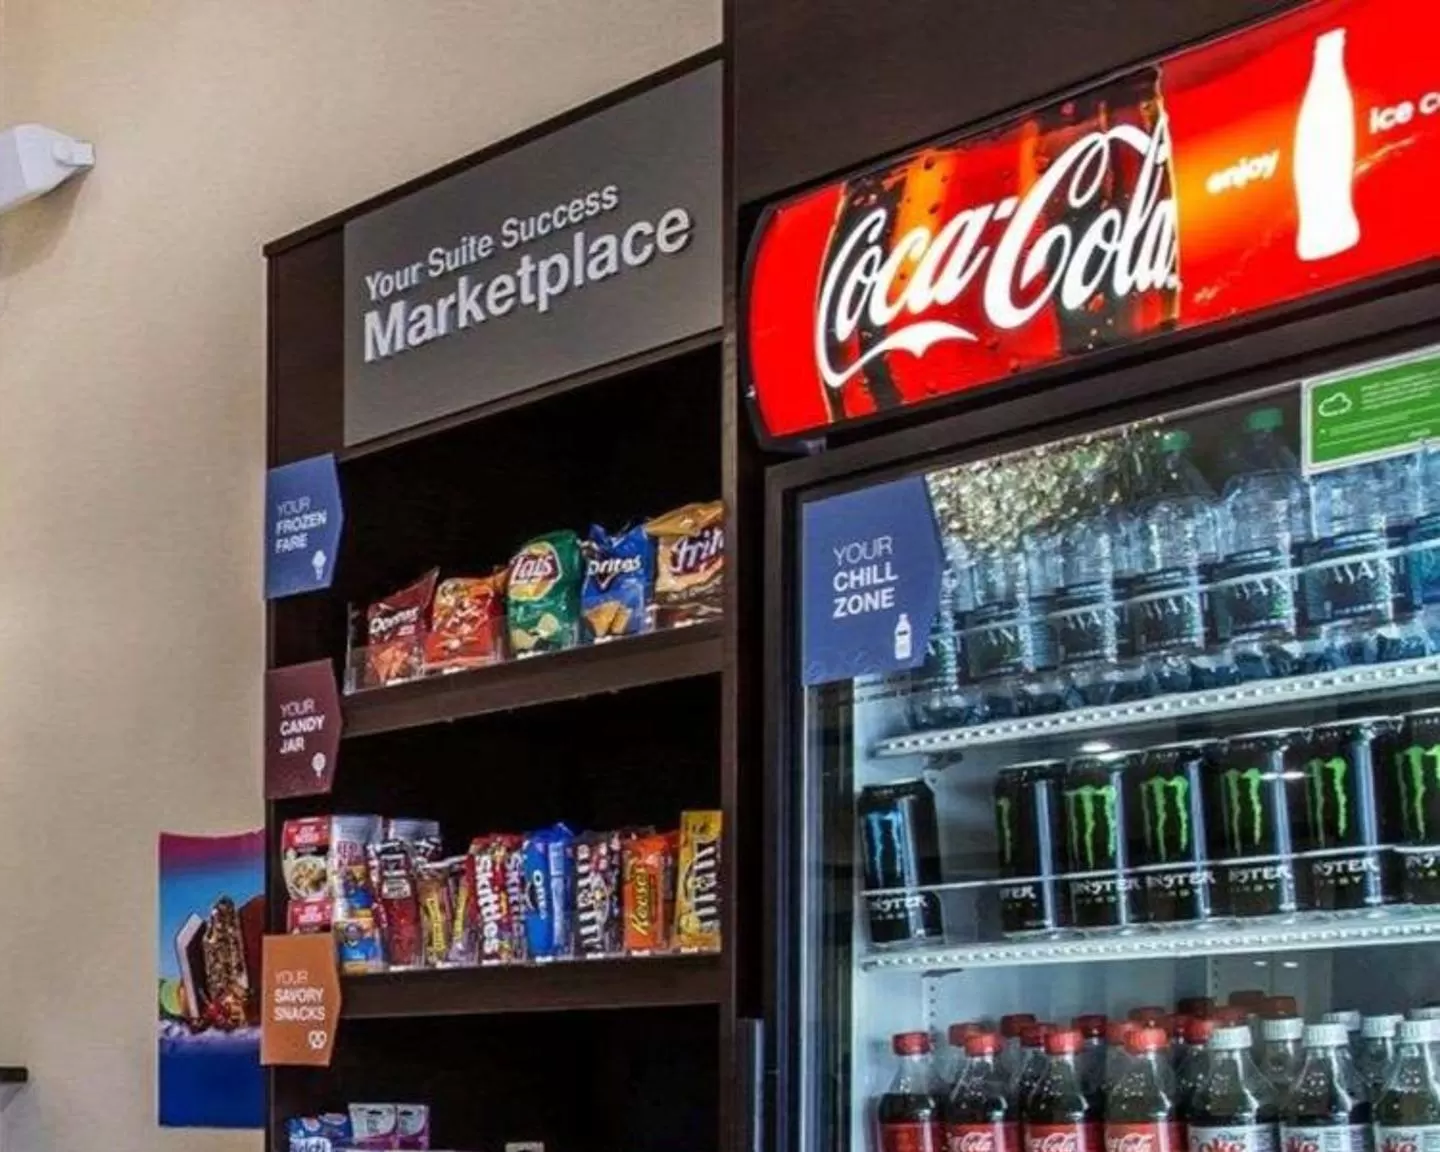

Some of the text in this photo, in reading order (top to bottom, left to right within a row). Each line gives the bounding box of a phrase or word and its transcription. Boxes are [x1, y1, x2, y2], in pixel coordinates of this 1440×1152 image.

[1206, 149, 1280, 194] enjoy
[364, 184, 620, 301] Your Suite Success
[816, 118, 1182, 388] Coca-Cola
[363, 207, 692, 362] Marketplace
[277, 496, 311, 516] YOUR
[275, 509, 328, 536] FROZEN
[275, 532, 308, 553] FARE
[832, 535, 893, 566] YOUR
[832, 561, 899, 592] CHILL
[832, 586, 896, 618] ZONE
[280, 698, 315, 718] YOUR
[279, 715, 326, 736] CANDY
[279, 736, 305, 754] JAR
[475, 854, 501, 954] Skittles
[274, 987, 324, 1004] SAVORY
[274, 1005, 326, 1021] SNACKS
